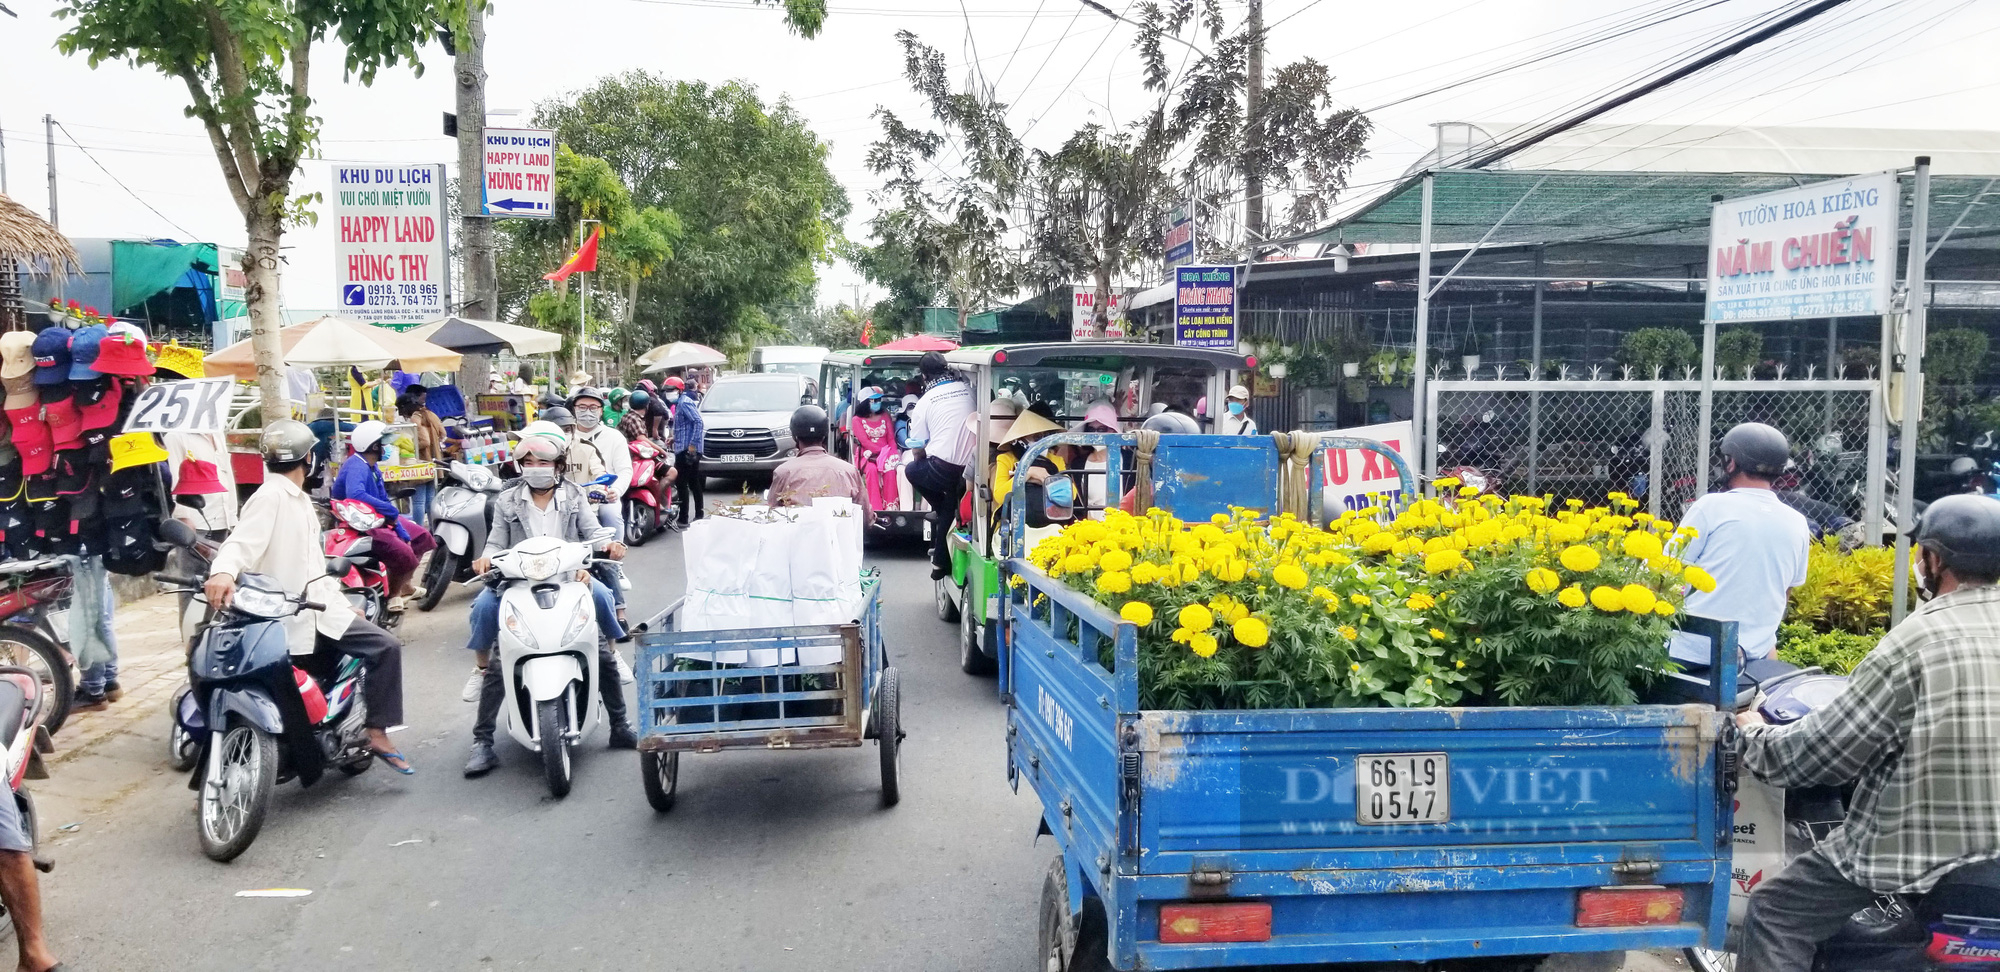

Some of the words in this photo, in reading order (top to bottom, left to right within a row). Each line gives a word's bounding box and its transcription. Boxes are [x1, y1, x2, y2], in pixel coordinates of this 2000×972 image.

[487, 136, 508, 145] KHU
[511, 137, 525, 145] DU
[528, 137, 550, 149] LỊCH
[487, 152, 520, 165] HAPPY
[523, 153, 549, 166] LAND
[340, 169, 369, 183] KHU
[375, 169, 393, 183] DU
[399, 169, 431, 186] LỊCH
[488, 168, 522, 190] HÙNG
[526, 173, 550, 192] THY
[340, 191, 355, 205] VUI
[358, 189, 379, 205] CHƠI
[382, 188, 403, 208] MIỆT
[407, 188, 430, 205] VƯỜN
[1738, 203, 1778, 227] VƯỜN
[1783, 199, 1816, 220] HOA
[1822, 182, 1879, 214] KIỂNG
[340, 216, 390, 243] HAPPY
[394, 216, 435, 243] LAND
[1716, 238, 1774, 278] NĂM
[1782, 215, 1875, 271] CHIẾN
[348, 248, 394, 281] HÙNG
[399, 255, 429, 281] THY
[368, 285, 395, 295] 0918.
[399, 284, 416, 294] 708
[420, 284, 437, 294] 965
[1736, 279, 1757, 295] XUẤT
[1760, 279, 1770, 292] VÀ
[1774, 279, 1797, 291] CUNG
[1800, 274, 1819, 290] ỨNG
[1822, 275, 1841, 287] HOA
[1844, 266, 1876, 286] KIỂNG
[369, 296, 399, 305] 02773.
[402, 296, 418, 305] 764
[422, 296, 438, 305] 757
[1178, 283, 1206, 305] HOÀNG
[1205, 287, 1233, 305] KHANG
[1179, 315, 1190, 325] CÁC
[1191, 316, 1203, 326] LOẠI
[1204, 316, 1215, 325] HOA
[1184, 328, 1195, 338] CÂY
[129, 381, 230, 429] 25K
[1371, 759, 1396, 787] 66
[1410, 758, 1435, 787] L9
[1371, 791, 1436, 819] 0547
[1731, 873, 1750, 882] BEEF
